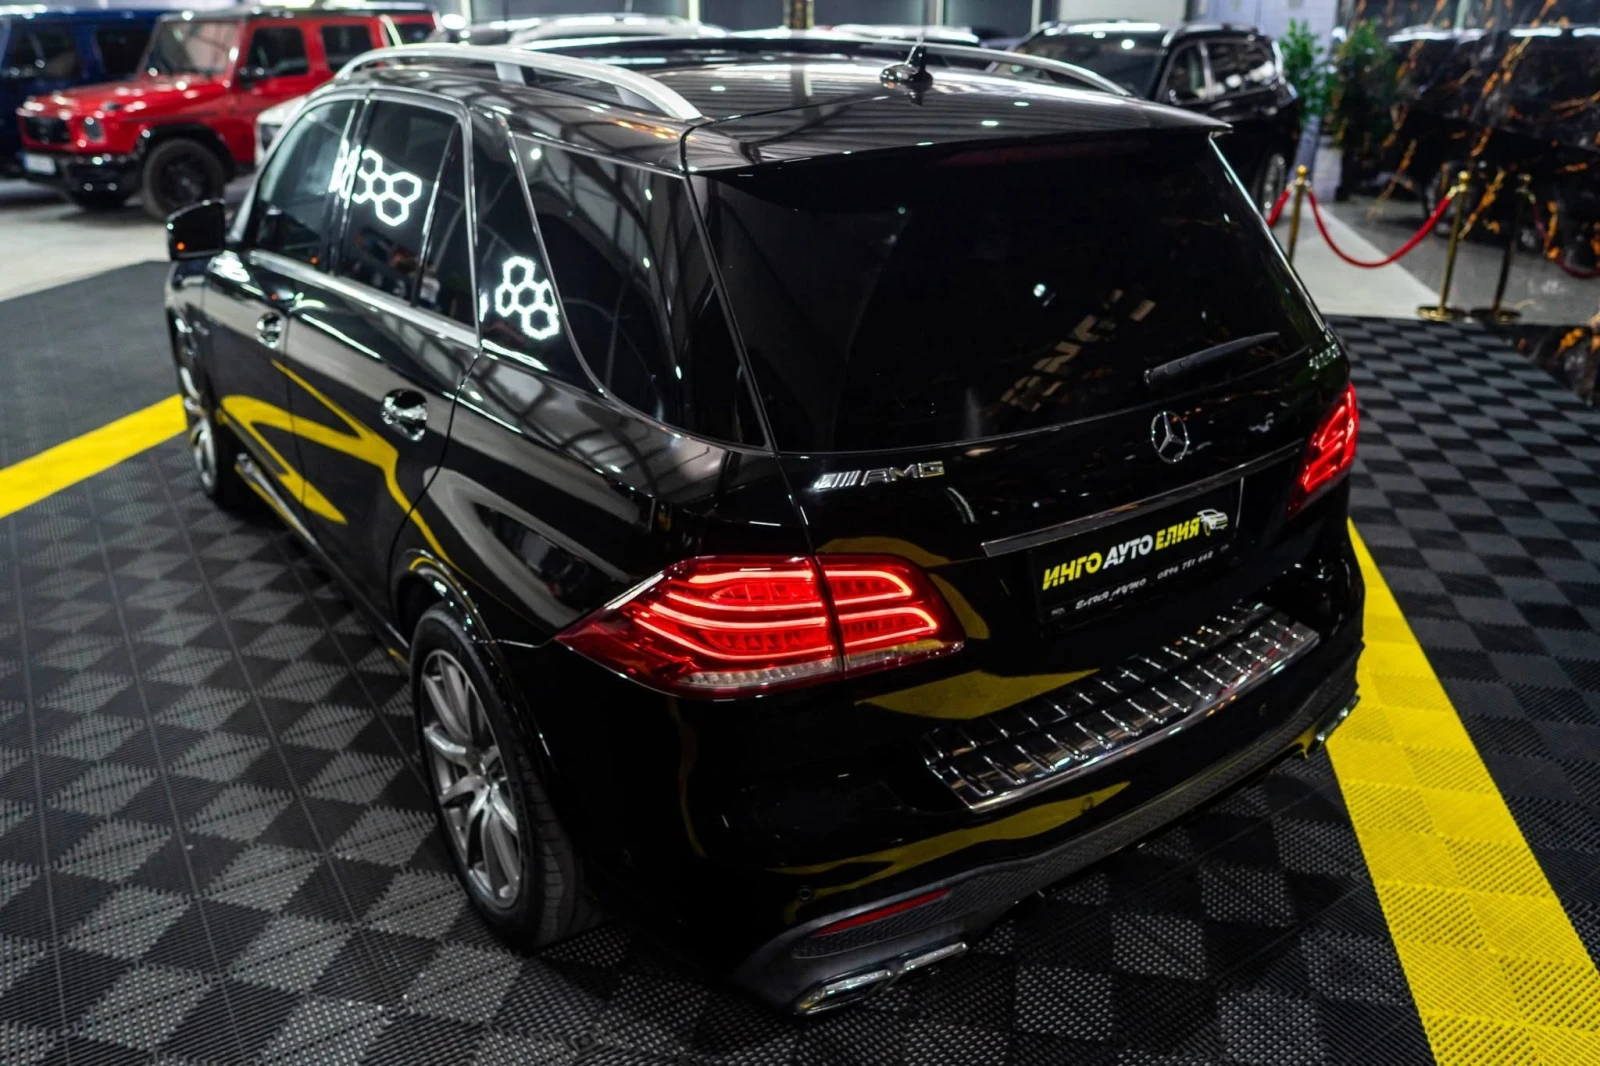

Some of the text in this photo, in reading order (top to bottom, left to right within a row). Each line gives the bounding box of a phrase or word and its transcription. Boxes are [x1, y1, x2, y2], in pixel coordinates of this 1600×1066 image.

[860, 461, 945, 486] AMG
[1042, 516, 1200, 591] ИНГО АУТО ЕЛИЯ
